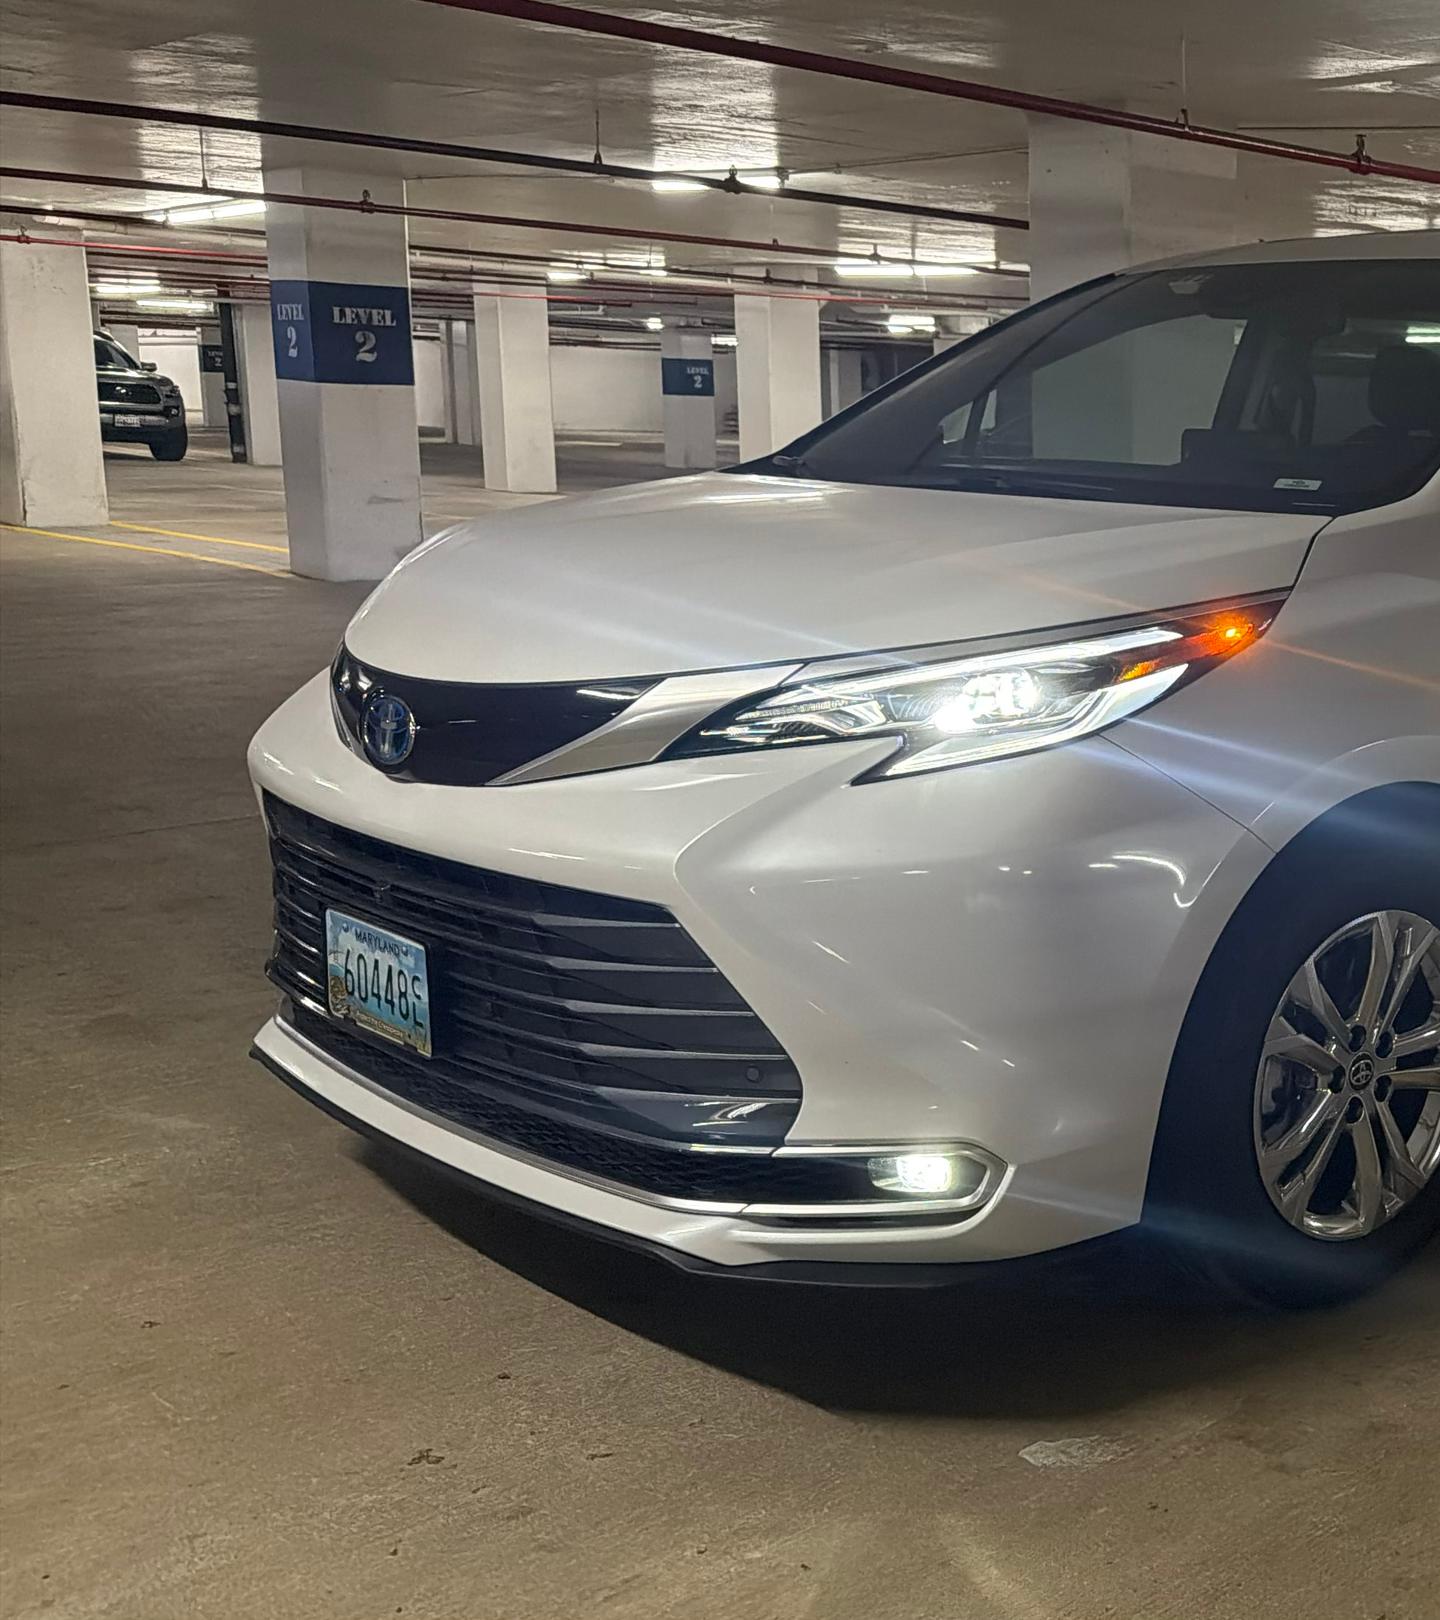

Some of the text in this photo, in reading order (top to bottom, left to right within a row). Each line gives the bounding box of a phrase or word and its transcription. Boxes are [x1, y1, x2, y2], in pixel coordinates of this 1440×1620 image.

[277, 304, 304, 320] LEVEL
[332, 306, 396, 327] LEVEL
[287, 326, 298, 358] 2
[355, 331, 377, 362] 2
[687, 367, 709, 375] LEVEL
[694, 375, 703, 388] 2
[354, 928, 400, 956] MARYLAND
